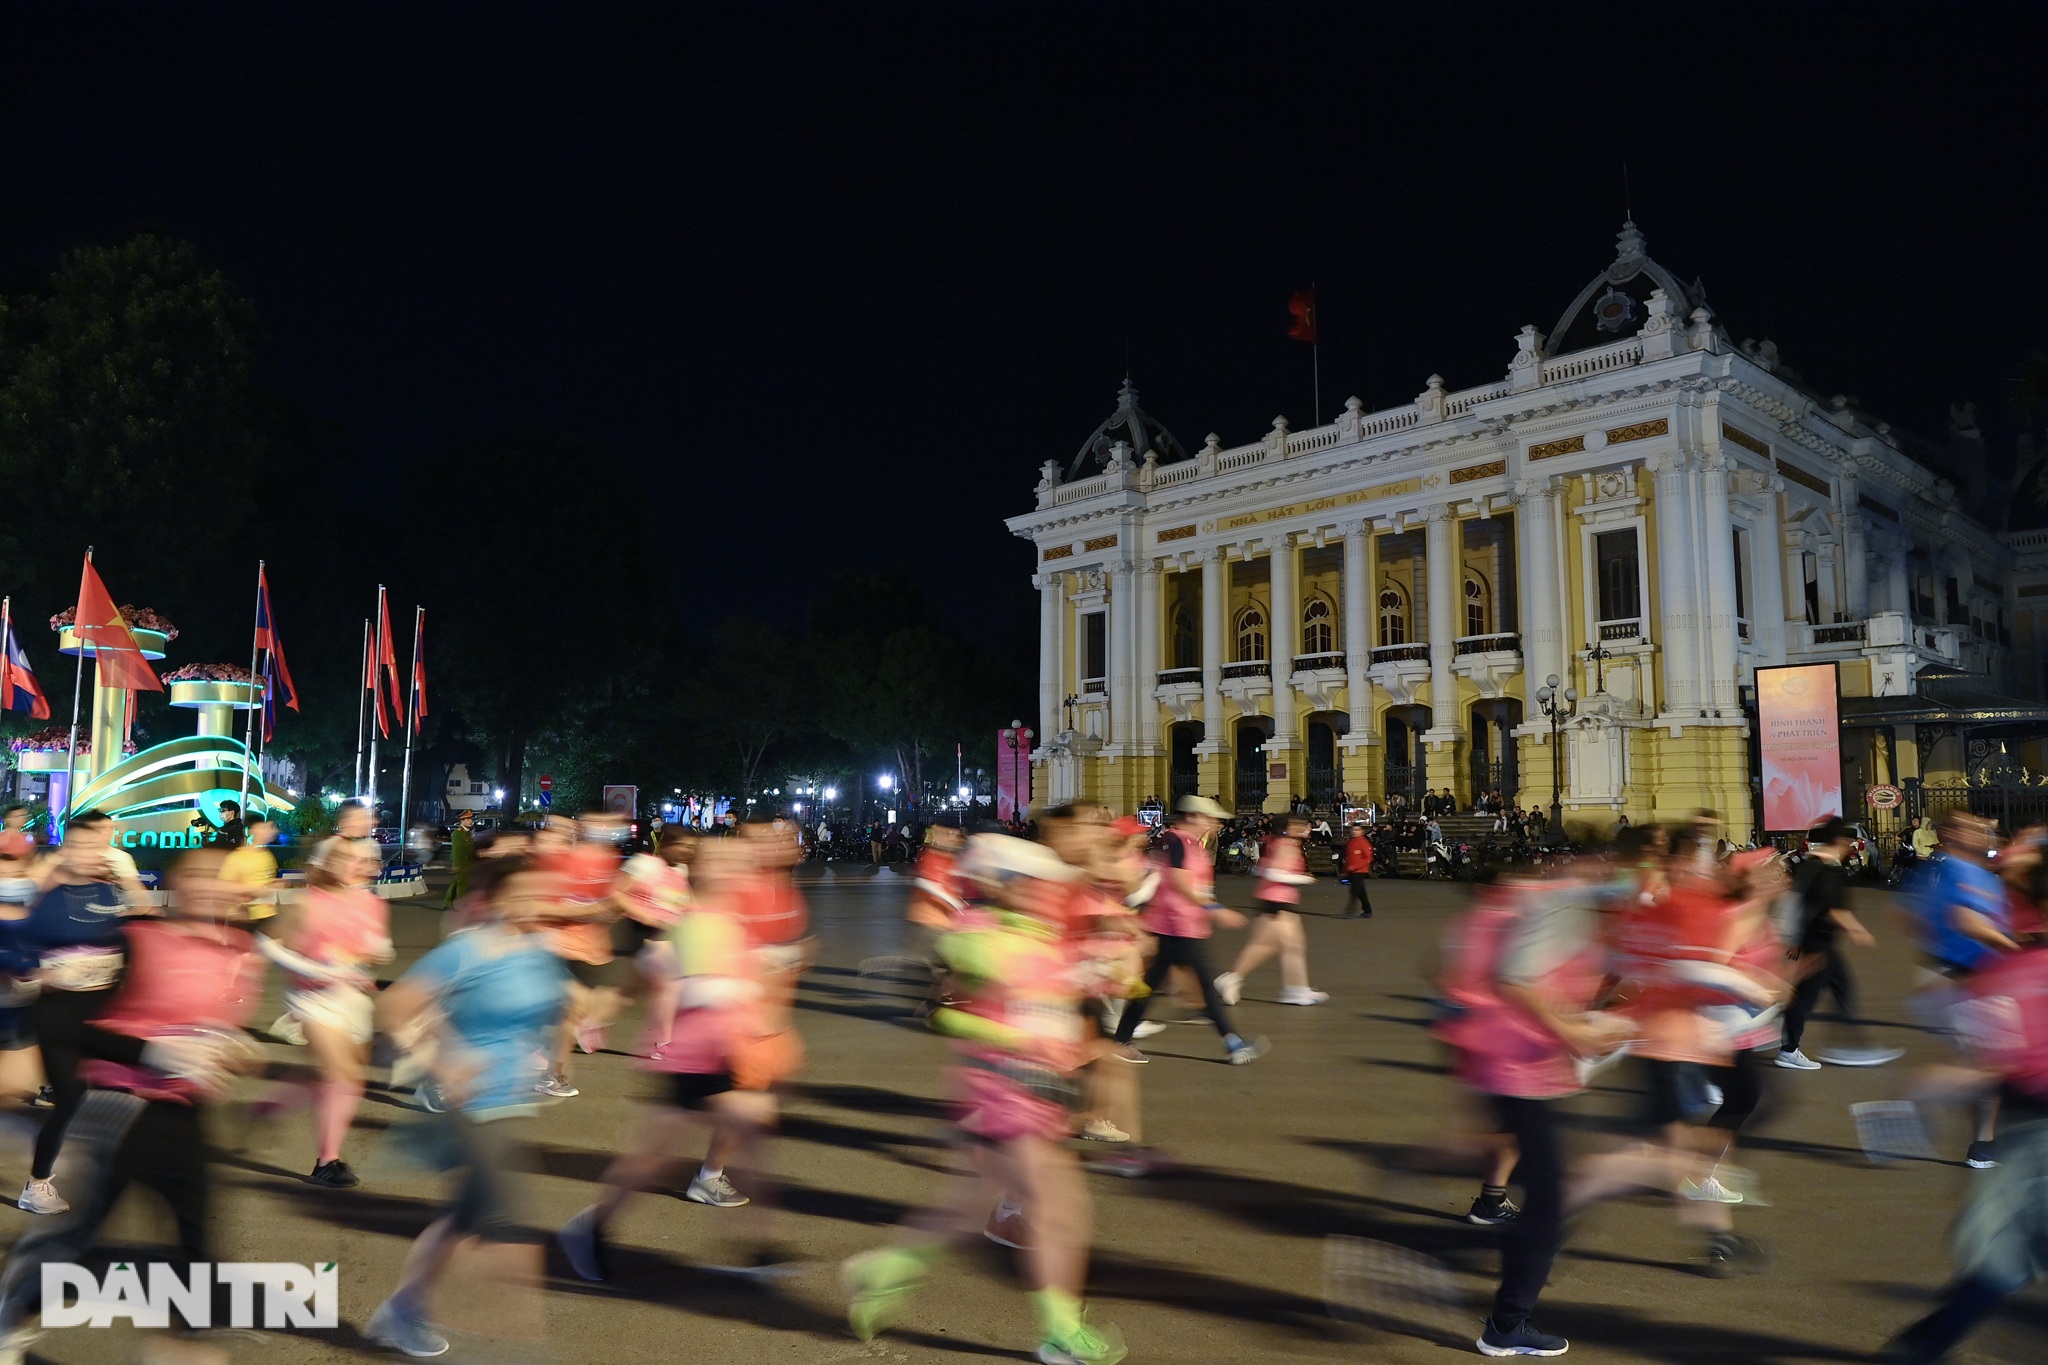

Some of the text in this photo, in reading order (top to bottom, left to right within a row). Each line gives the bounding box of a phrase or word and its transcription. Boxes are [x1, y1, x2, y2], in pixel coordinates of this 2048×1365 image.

[1229, 512, 1257, 528] NHÀ
[1267, 506, 1295, 520] HÁT
[1347, 489, 1368, 504] HÀ
[1381, 482, 1409, 497] NỘI
[1811, 741, 1838, 750] GROUP
[1868, 785, 1901, 797] HIGHLANDS
